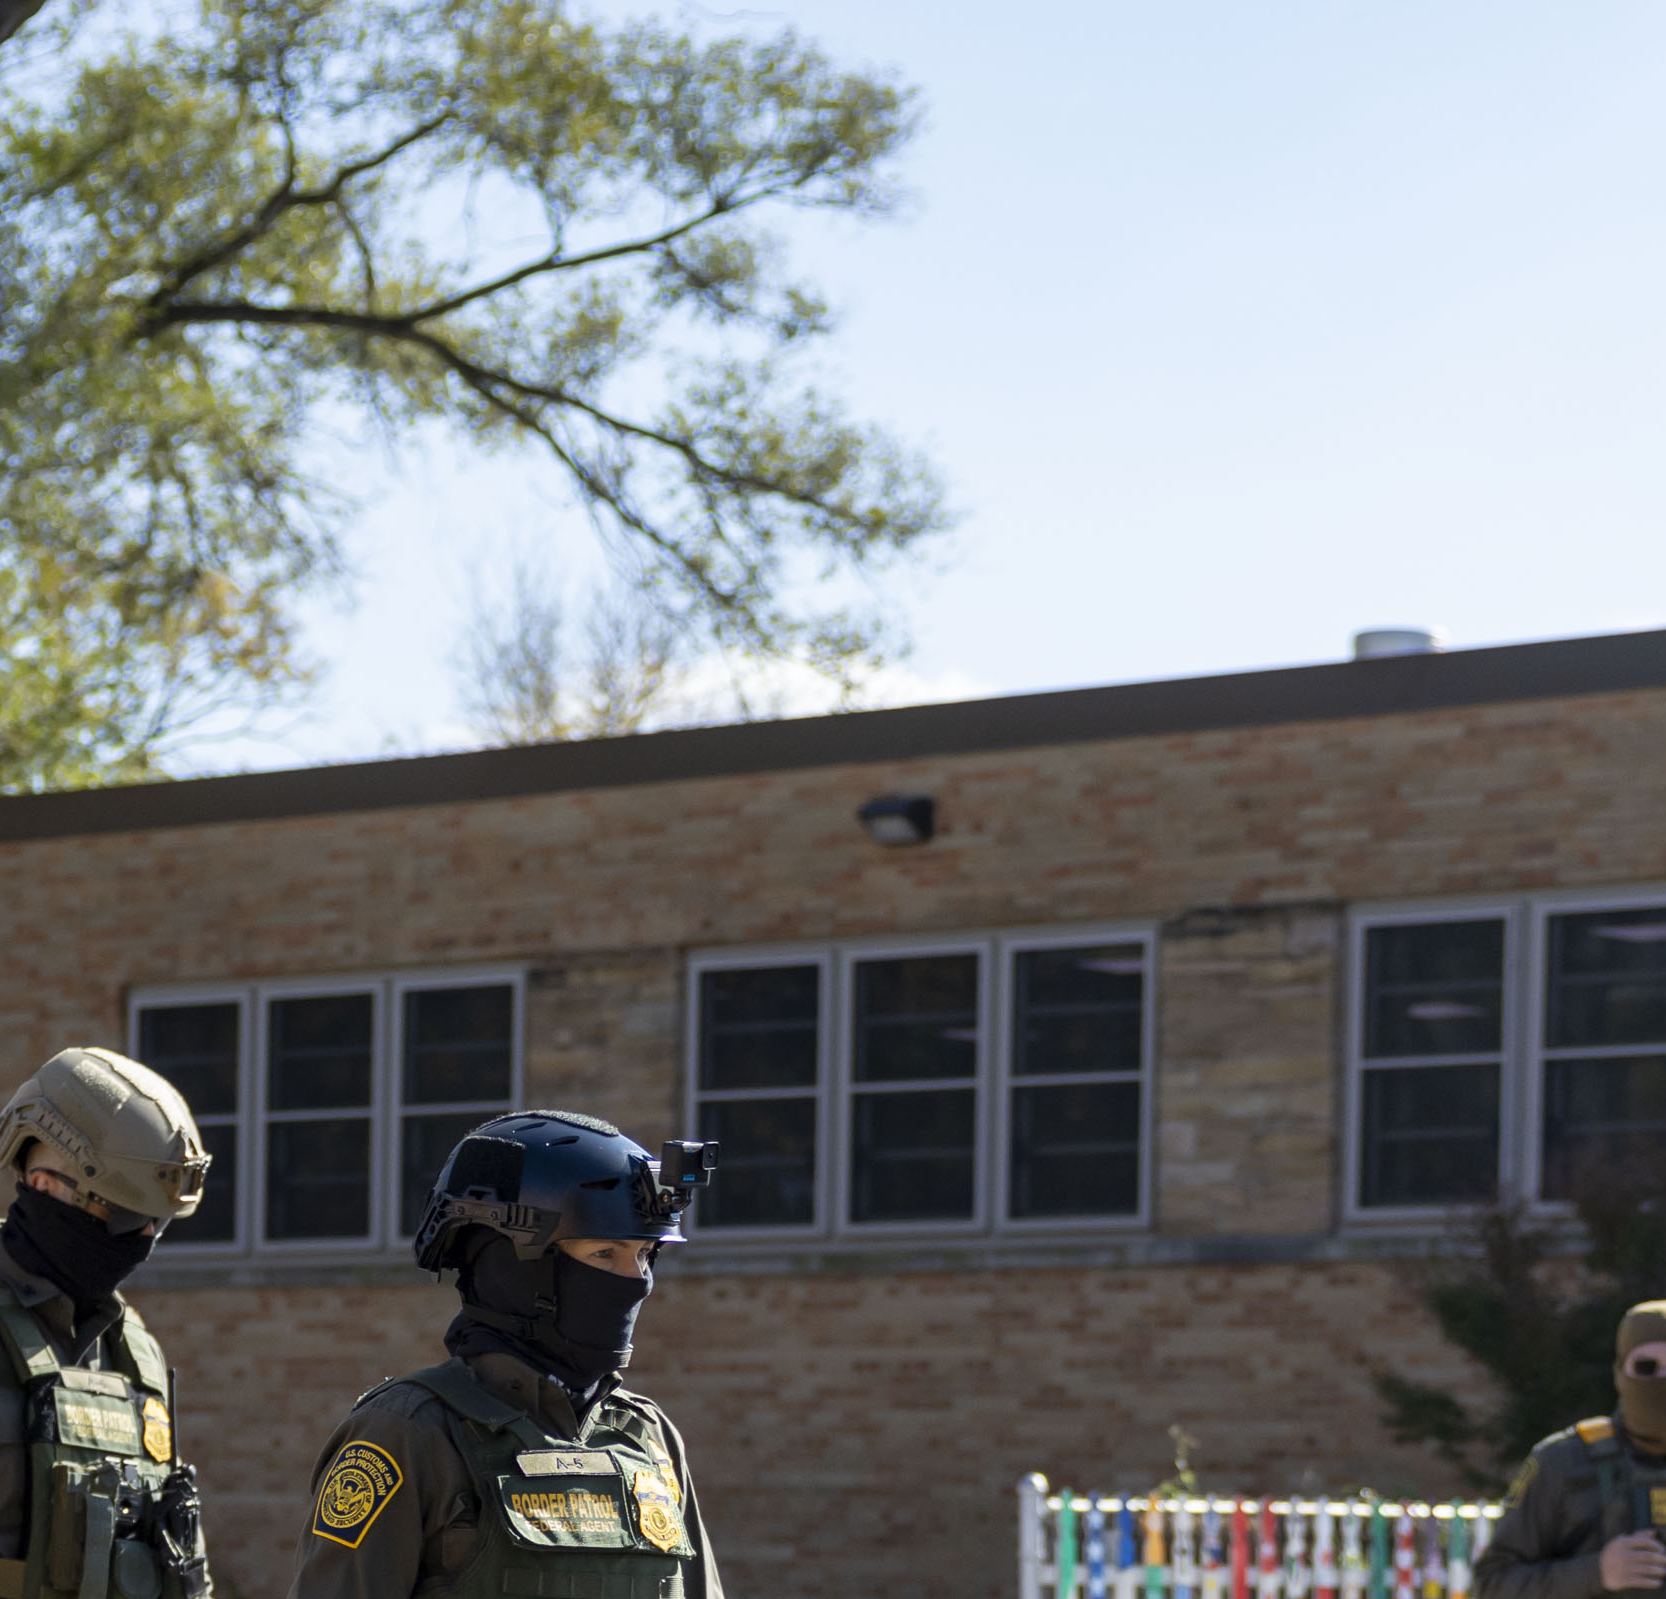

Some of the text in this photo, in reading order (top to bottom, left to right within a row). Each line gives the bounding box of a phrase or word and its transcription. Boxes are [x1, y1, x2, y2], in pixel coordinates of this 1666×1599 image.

[331, 1458, 356, 1476] BORDER
[356, 1459, 386, 1495] PROTECTION
[345, 1449, 356, 1458] U.S.
[357, 1449, 388, 1473] CUSTOMS
[384, 1473, 393, 1485] AND
[556, 1457, 584, 1470] A-5
[511, 1493, 619, 1519] BORDER PATROL
[524, 1520, 616, 1532] FEDERAL AGENT
